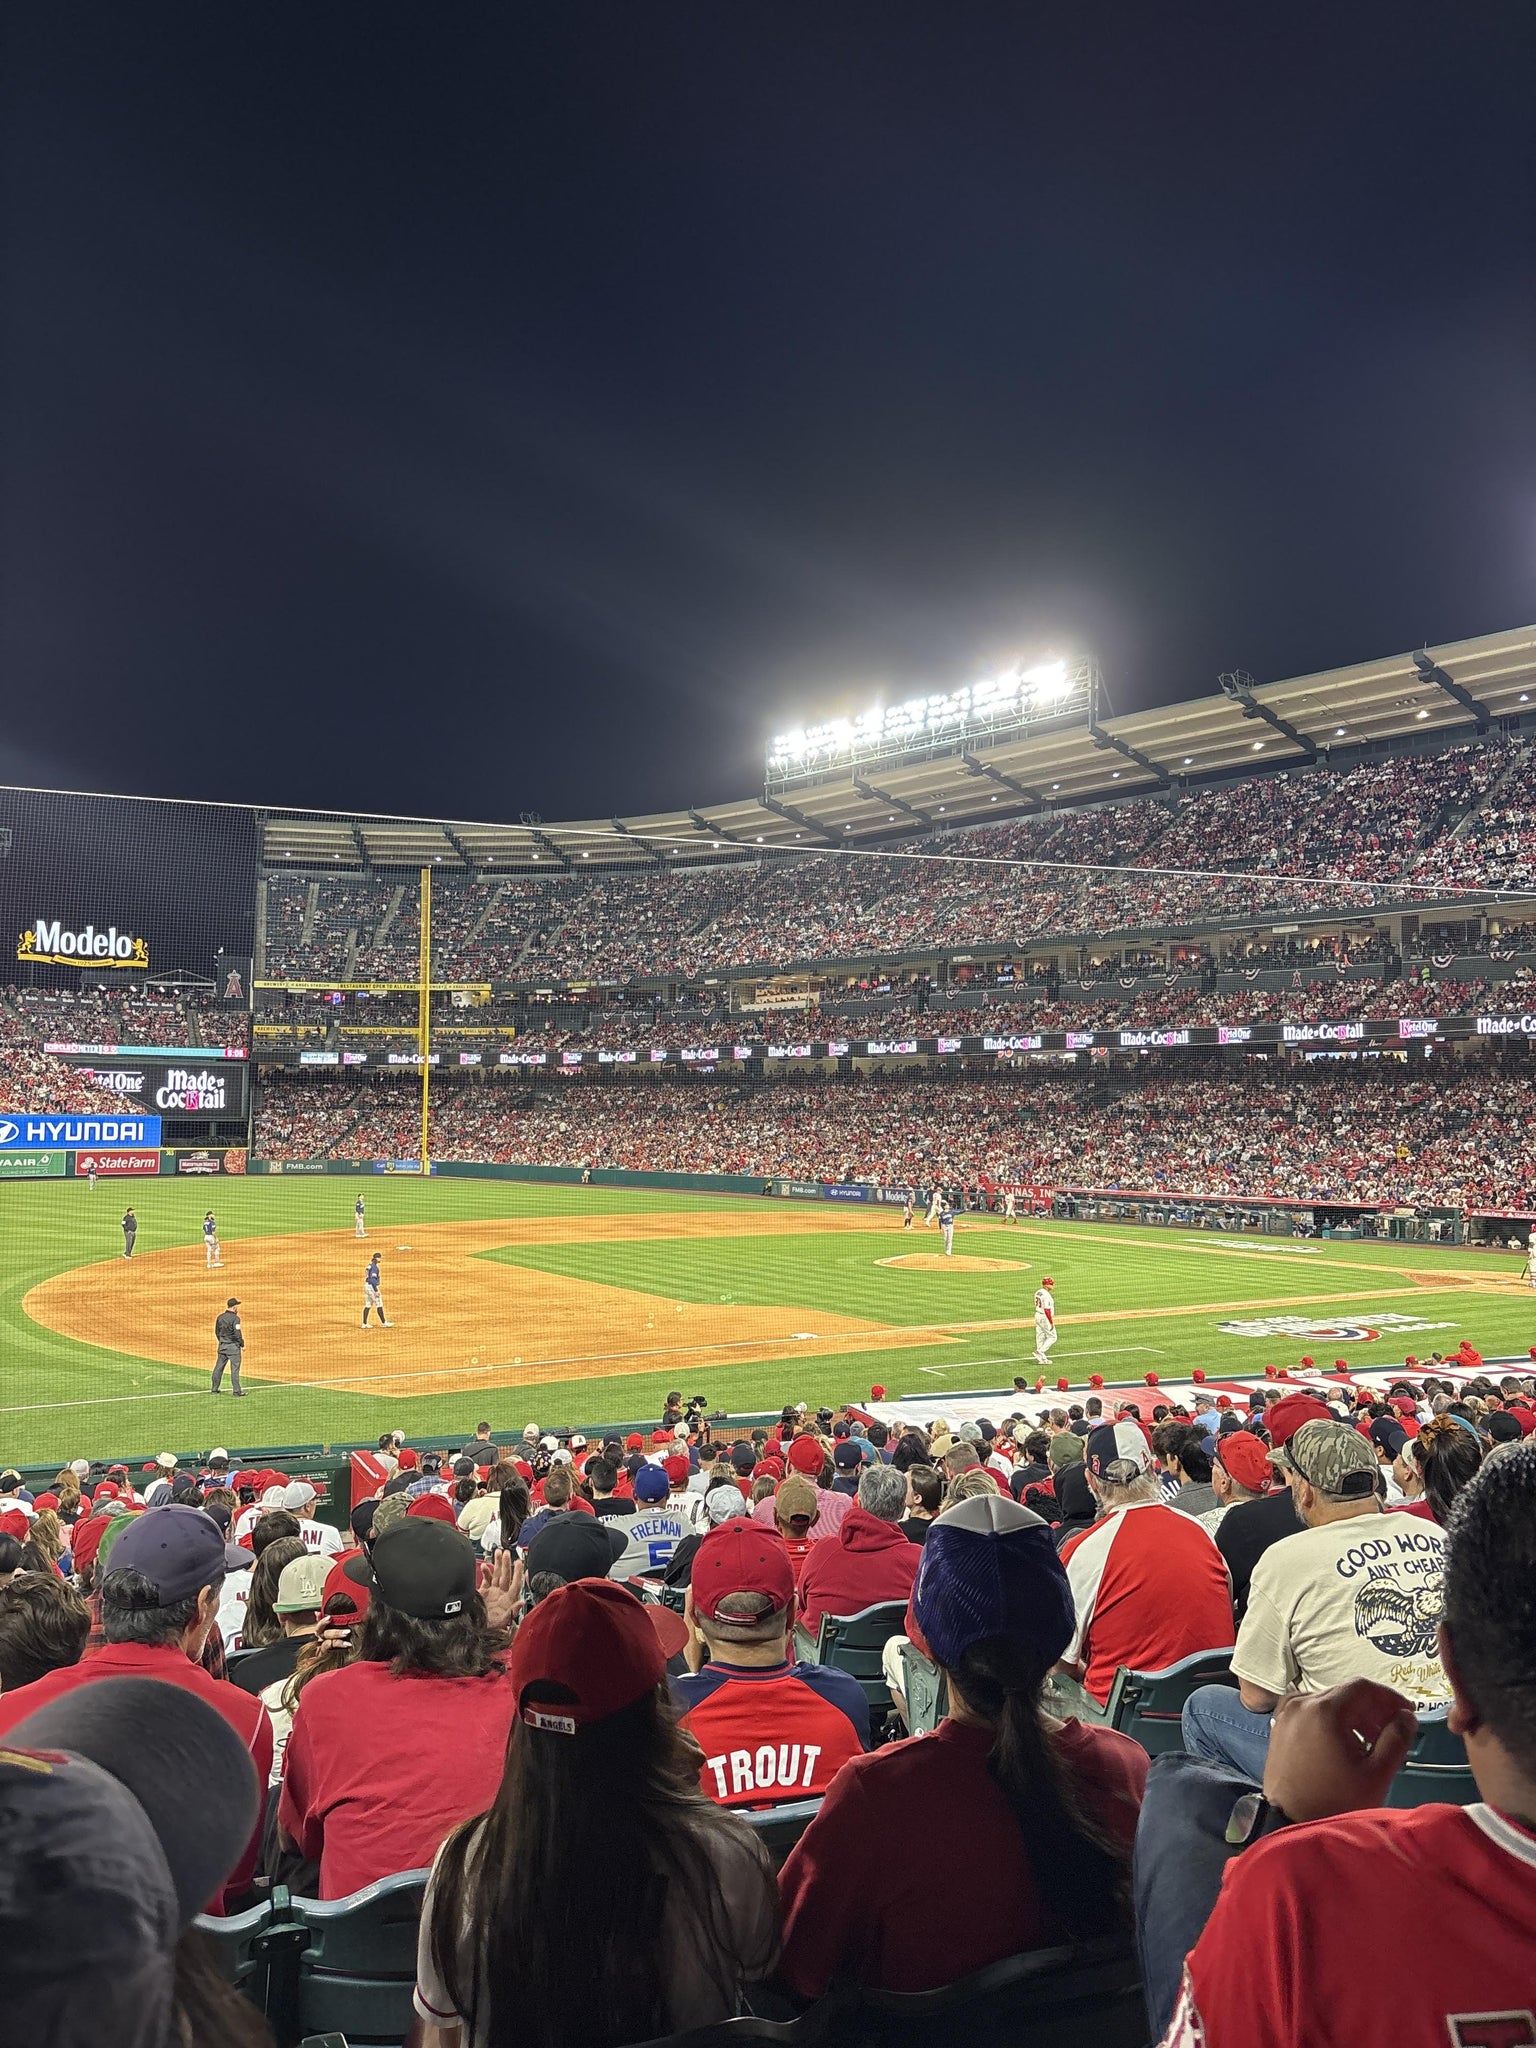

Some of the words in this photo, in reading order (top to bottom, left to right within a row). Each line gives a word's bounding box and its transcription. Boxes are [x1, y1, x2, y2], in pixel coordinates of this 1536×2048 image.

[36, 920, 132, 957] Modelo
[1283, 1025, 1314, 1041] Made
[1477, 1017, 1514, 1034] Made
[984, 1038, 1006, 1050] Made
[1120, 1032, 1146, 1046] Made
[115, 1073, 143, 1090] One
[168, 1070, 215, 1090] Made
[156, 1087, 226, 1110] Cocktail
[27, 1122, 144, 1142] HYUNDAI
[629, 1519, 682, 1542] FREEMAN
[648, 1541, 673, 1567] 5
[1336, 1539, 1392, 1578] GOOD
[1394, 1533, 1445, 1554] WOR
[1367, 1563, 1401, 1581] AIN'T
[300, 1576, 317, 1598] LA
[1391, 1662, 1416, 1683] Red,
[1417, 1662, 1442, 1682] White
[540, 1716, 573, 1733] ANGELS
[707, 1744, 821, 1798] TROUT
